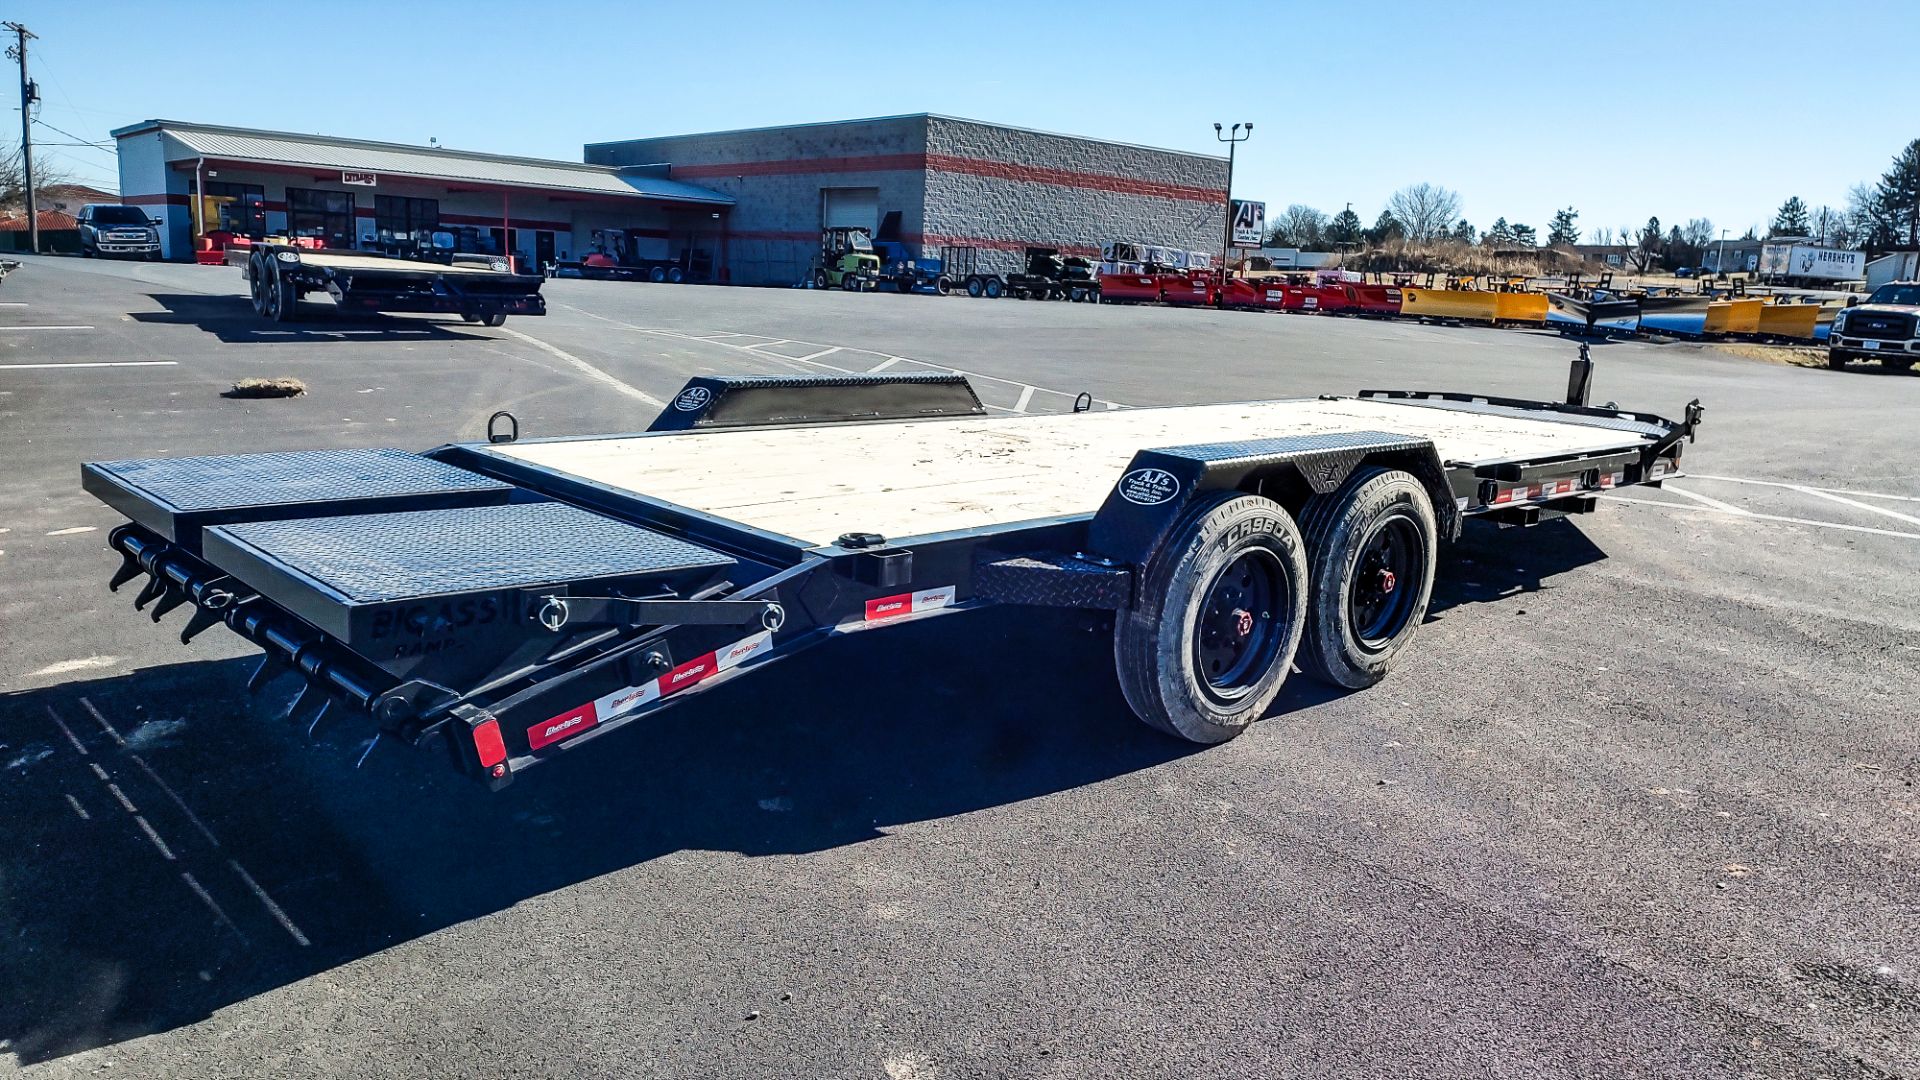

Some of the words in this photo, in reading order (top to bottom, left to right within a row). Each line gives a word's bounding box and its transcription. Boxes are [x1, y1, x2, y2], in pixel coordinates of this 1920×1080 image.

[1817, 250, 1856, 264] HERSHEY'S
[1128, 478, 1145, 487] Truck
[1151, 483, 1172, 493] Trailer
[1227, 517, 1293, 550] CR960A
